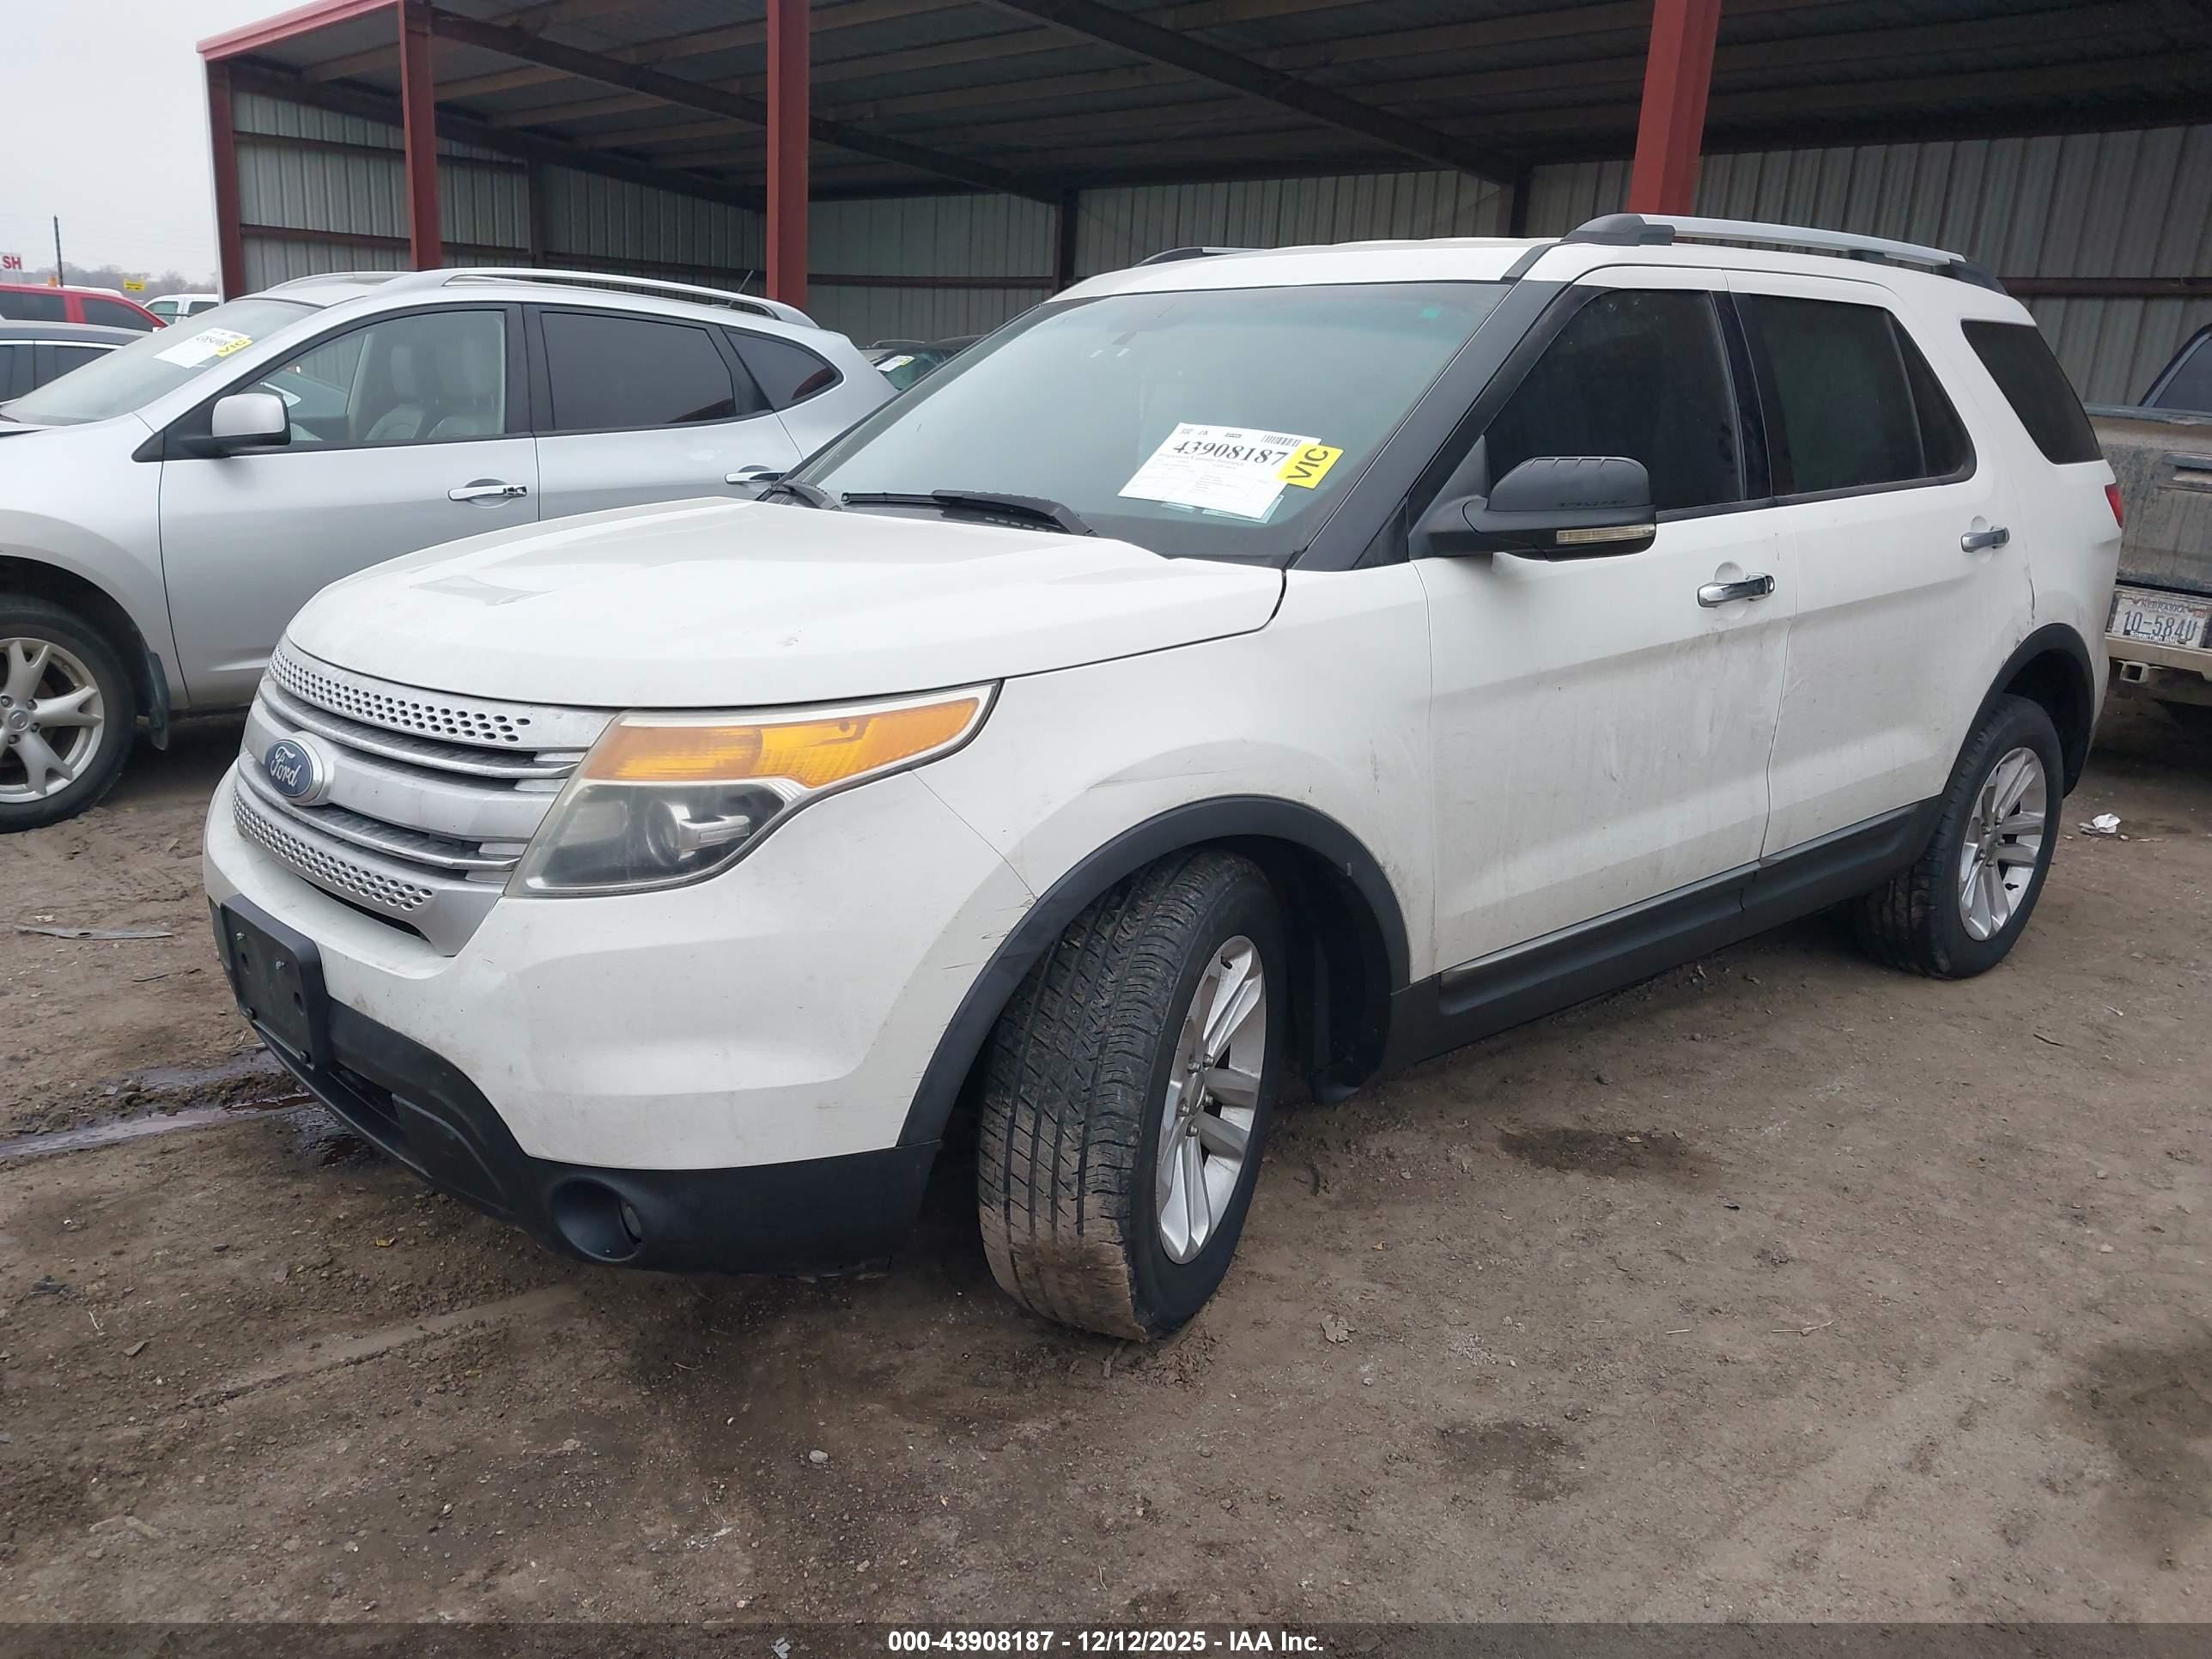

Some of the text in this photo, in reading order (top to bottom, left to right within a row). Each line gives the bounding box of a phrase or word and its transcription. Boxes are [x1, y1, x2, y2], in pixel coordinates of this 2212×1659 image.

[3, 255, 22, 270] SH
[1172, 440, 1288, 466] 43908187
[1285, 447, 1329, 480] VIC
[270, 745, 302, 787] Ford
